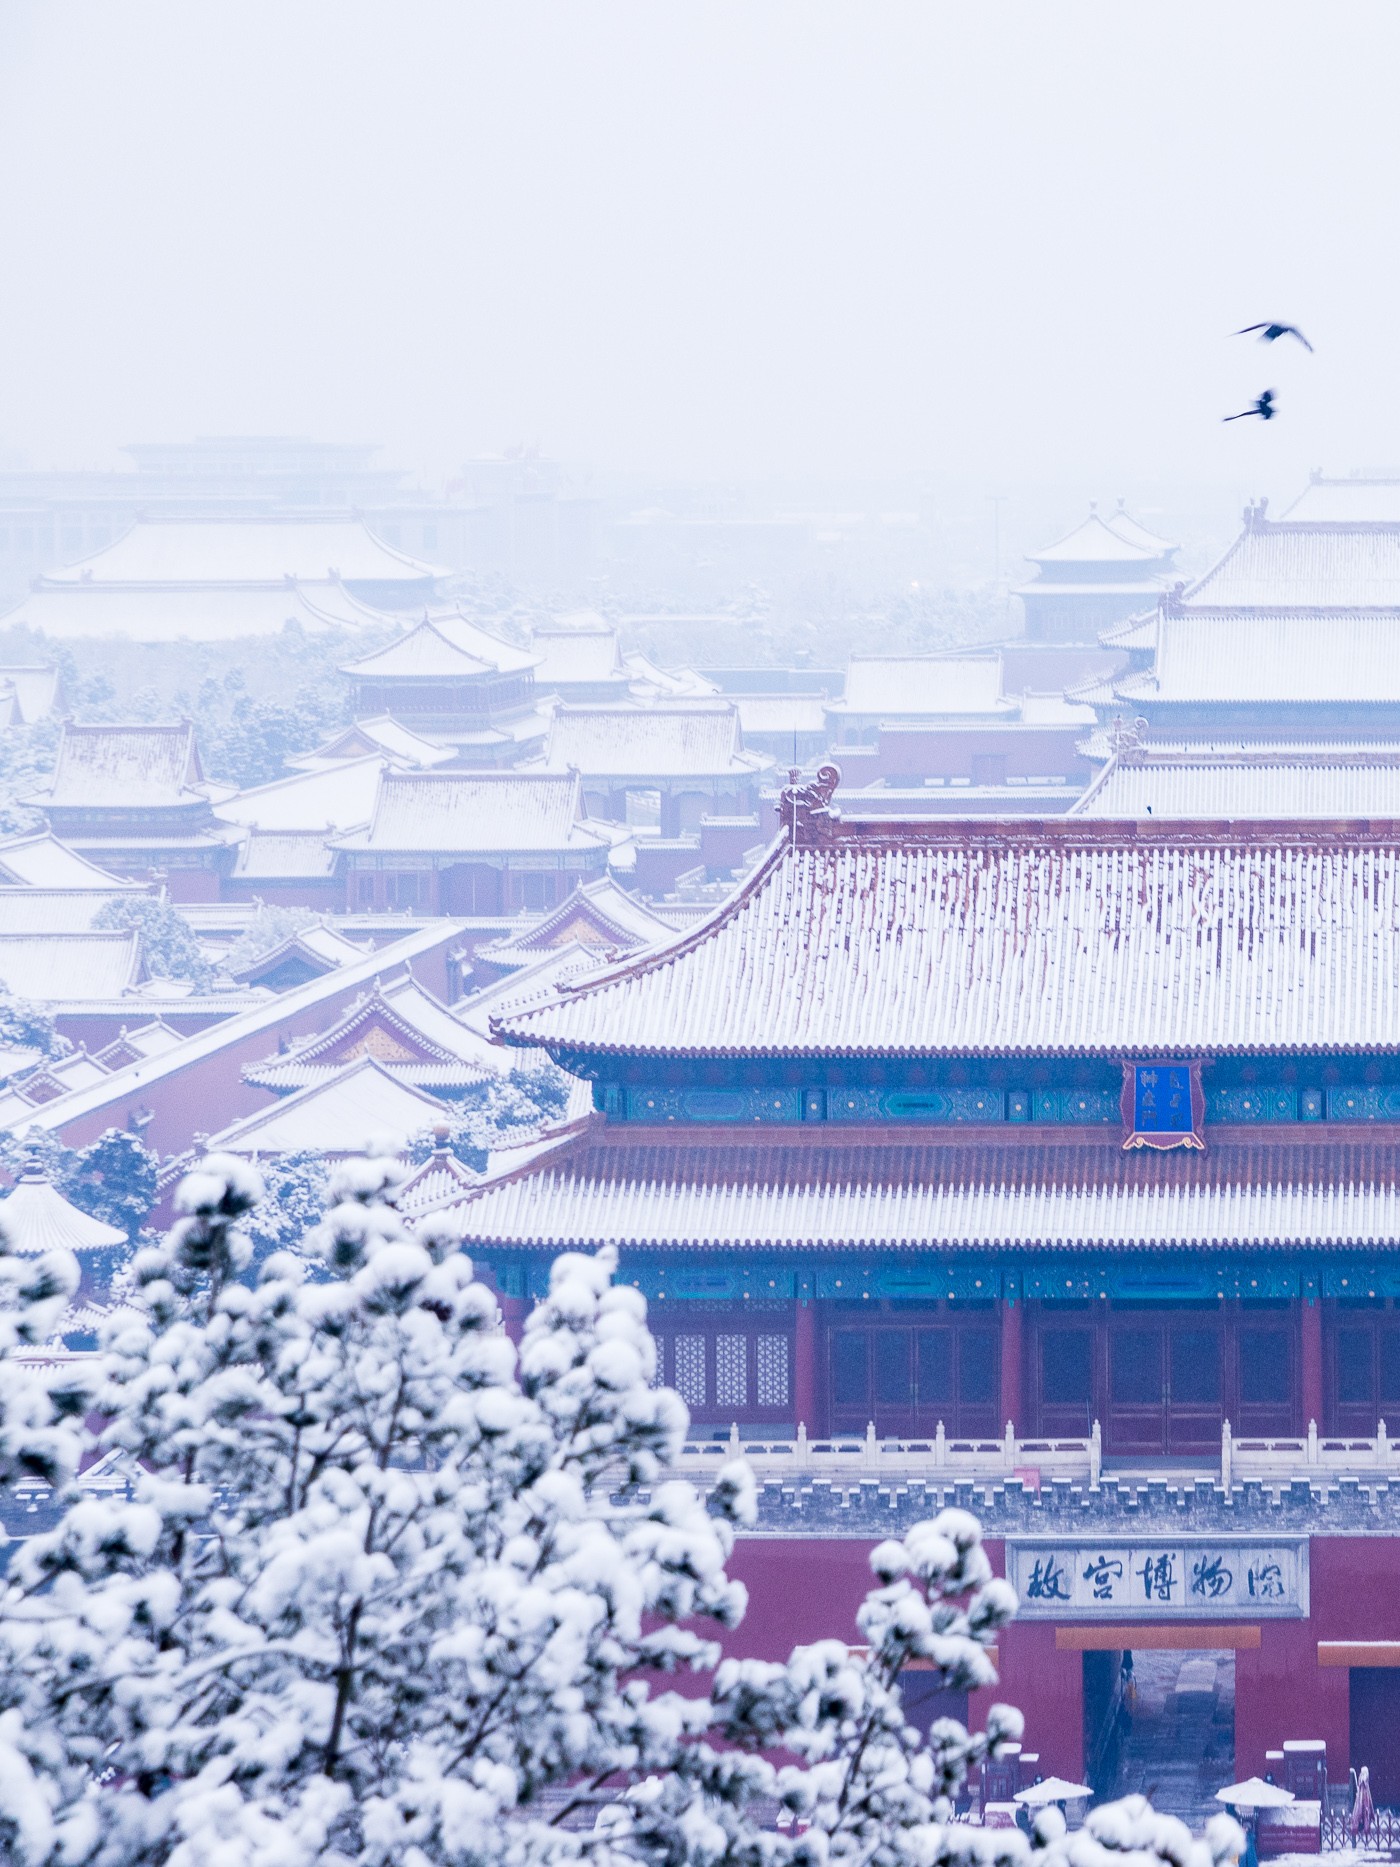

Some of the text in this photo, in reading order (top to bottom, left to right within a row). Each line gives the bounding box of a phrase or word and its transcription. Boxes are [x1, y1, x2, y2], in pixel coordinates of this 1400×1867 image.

[1027, 1554, 1284, 1600] 故宫博物院
